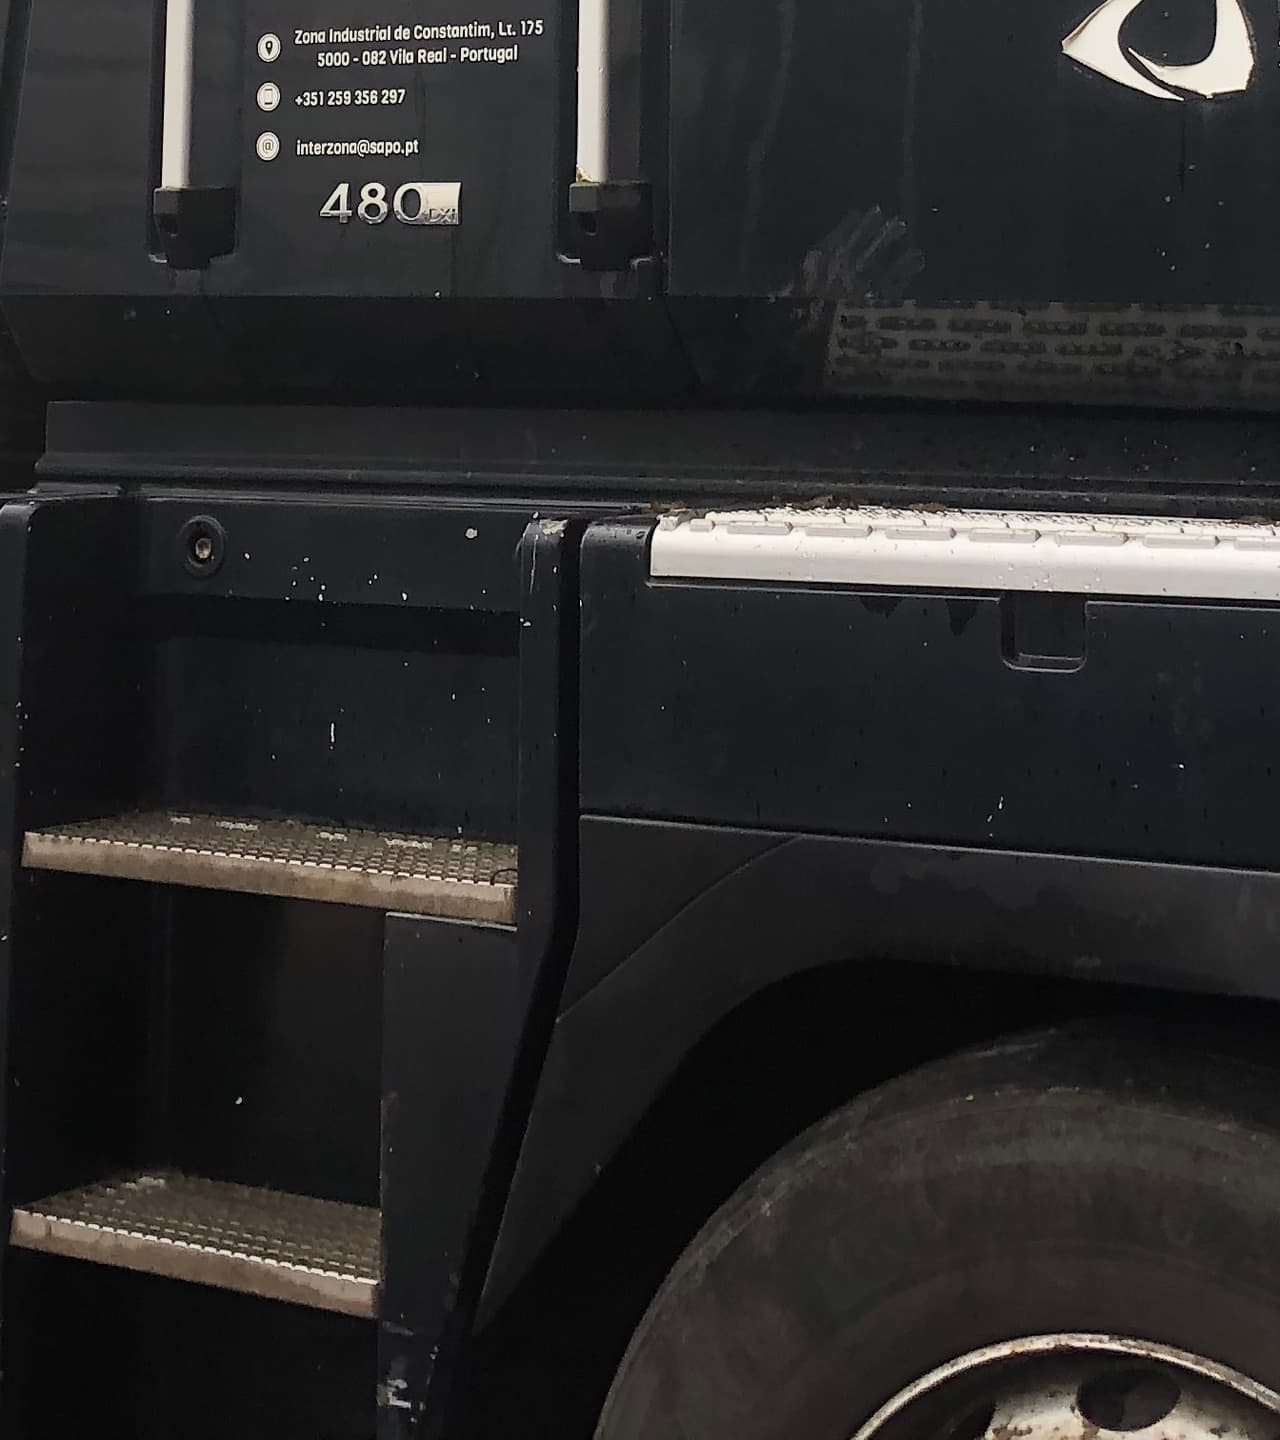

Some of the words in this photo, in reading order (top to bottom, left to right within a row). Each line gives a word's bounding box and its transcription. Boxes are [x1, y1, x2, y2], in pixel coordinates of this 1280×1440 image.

[295, 29, 326, 44] Zona
[329, 25, 390, 43] Industrial
[393, 24, 410, 40] de
[413, 22, 495, 40] Constantim,
[521, 20, 543, 36] 175
[317, 51, 349, 66] 5000
[362, 50, 386, 65] 082
[390, 48, 414, 65] Vila
[418, 48, 447, 63] Real
[460, 45, 518, 65] Portugal
[295, 92, 324, 107] +351
[327, 91, 351, 105] 259
[354, 90, 378, 105] 356
[381, 89, 406, 104] 297
[296, 139, 418, 157] interzona@sapo.pt
[320, 182, 425, 224] 480
